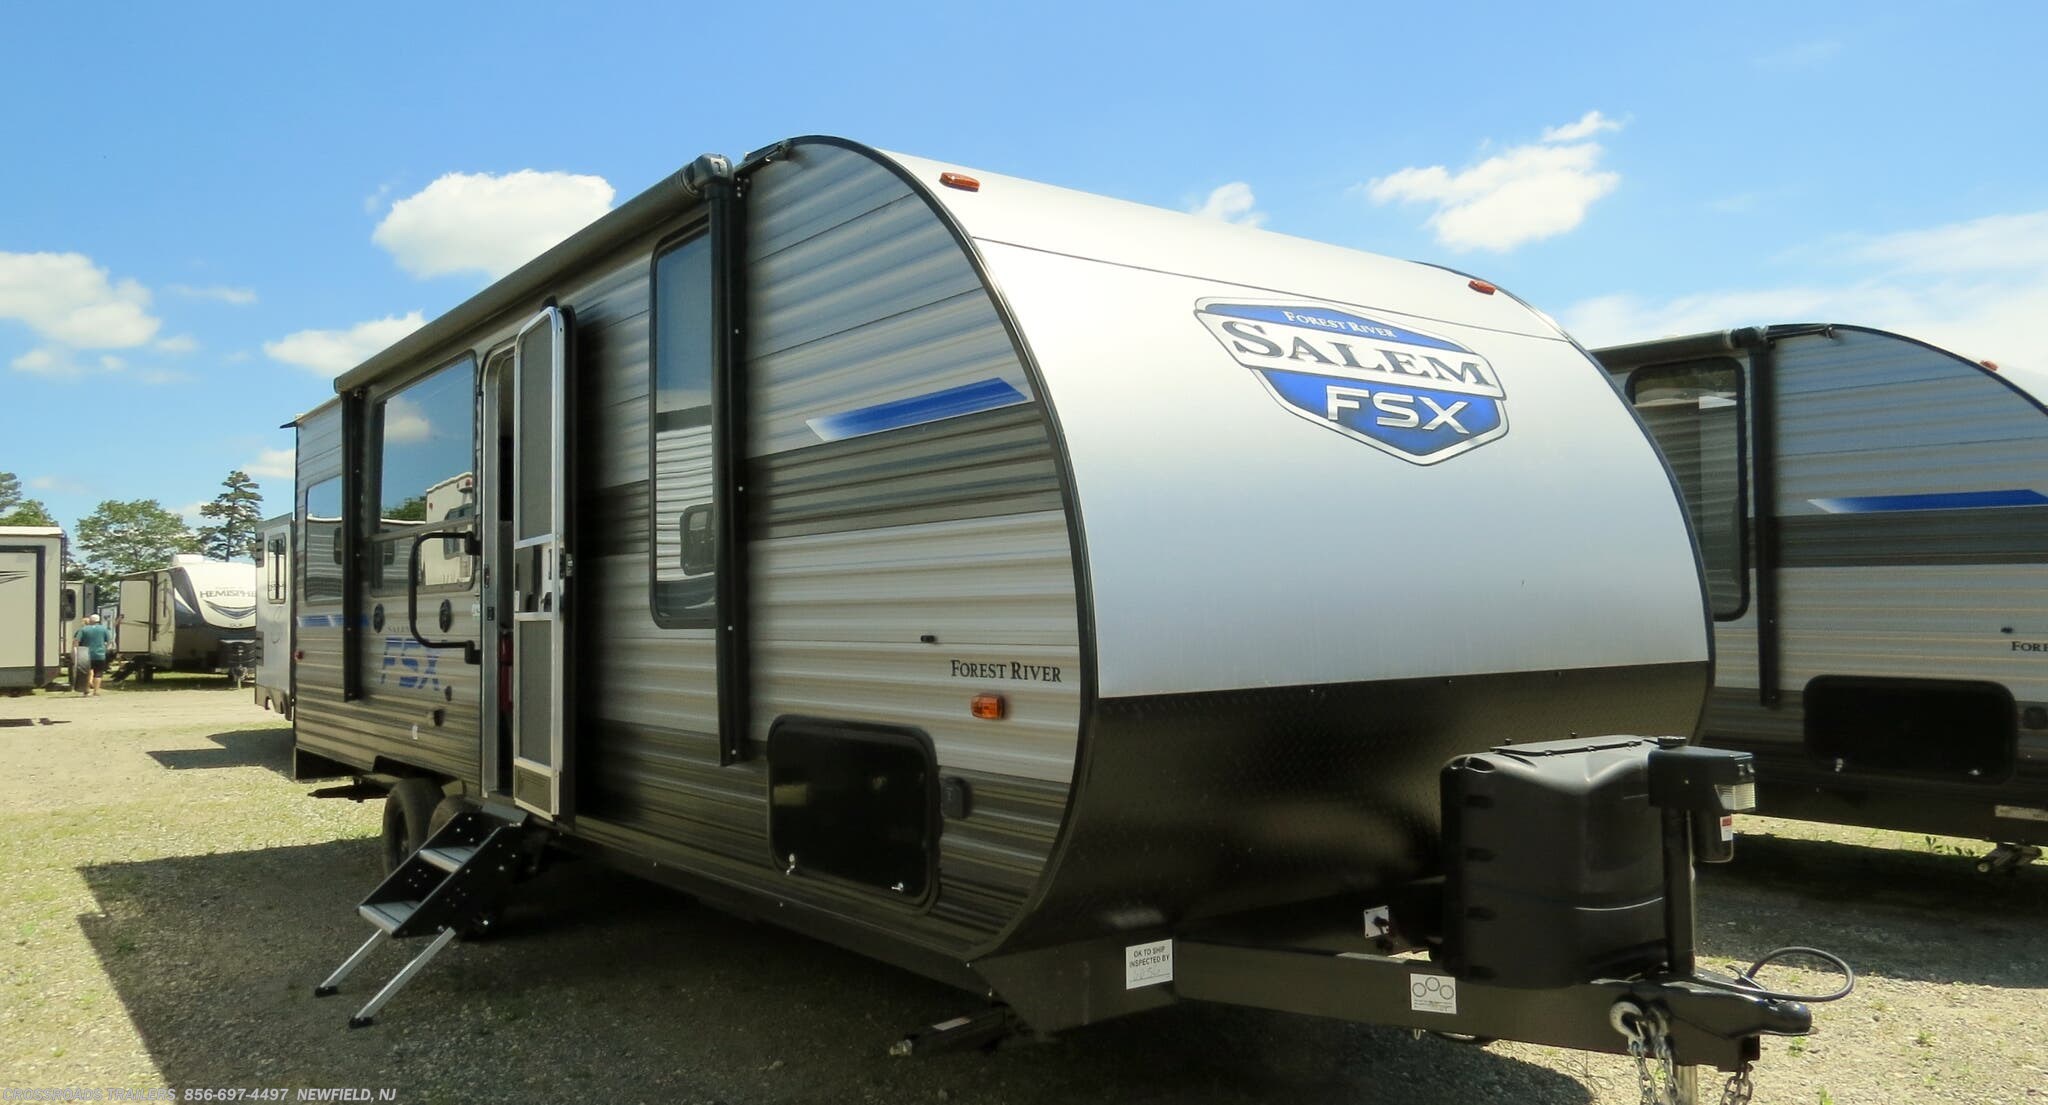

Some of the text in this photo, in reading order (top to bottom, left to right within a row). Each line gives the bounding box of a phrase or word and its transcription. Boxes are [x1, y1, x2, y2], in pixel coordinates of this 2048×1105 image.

[1282, 310, 1397, 338] FOREST RIVER
[1221, 320, 1496, 388] SALEM
[1326, 385, 1470, 434] FSX
[381, 637, 448, 690] FSX
[951, 659, 1062, 682] FOREST RIVER
